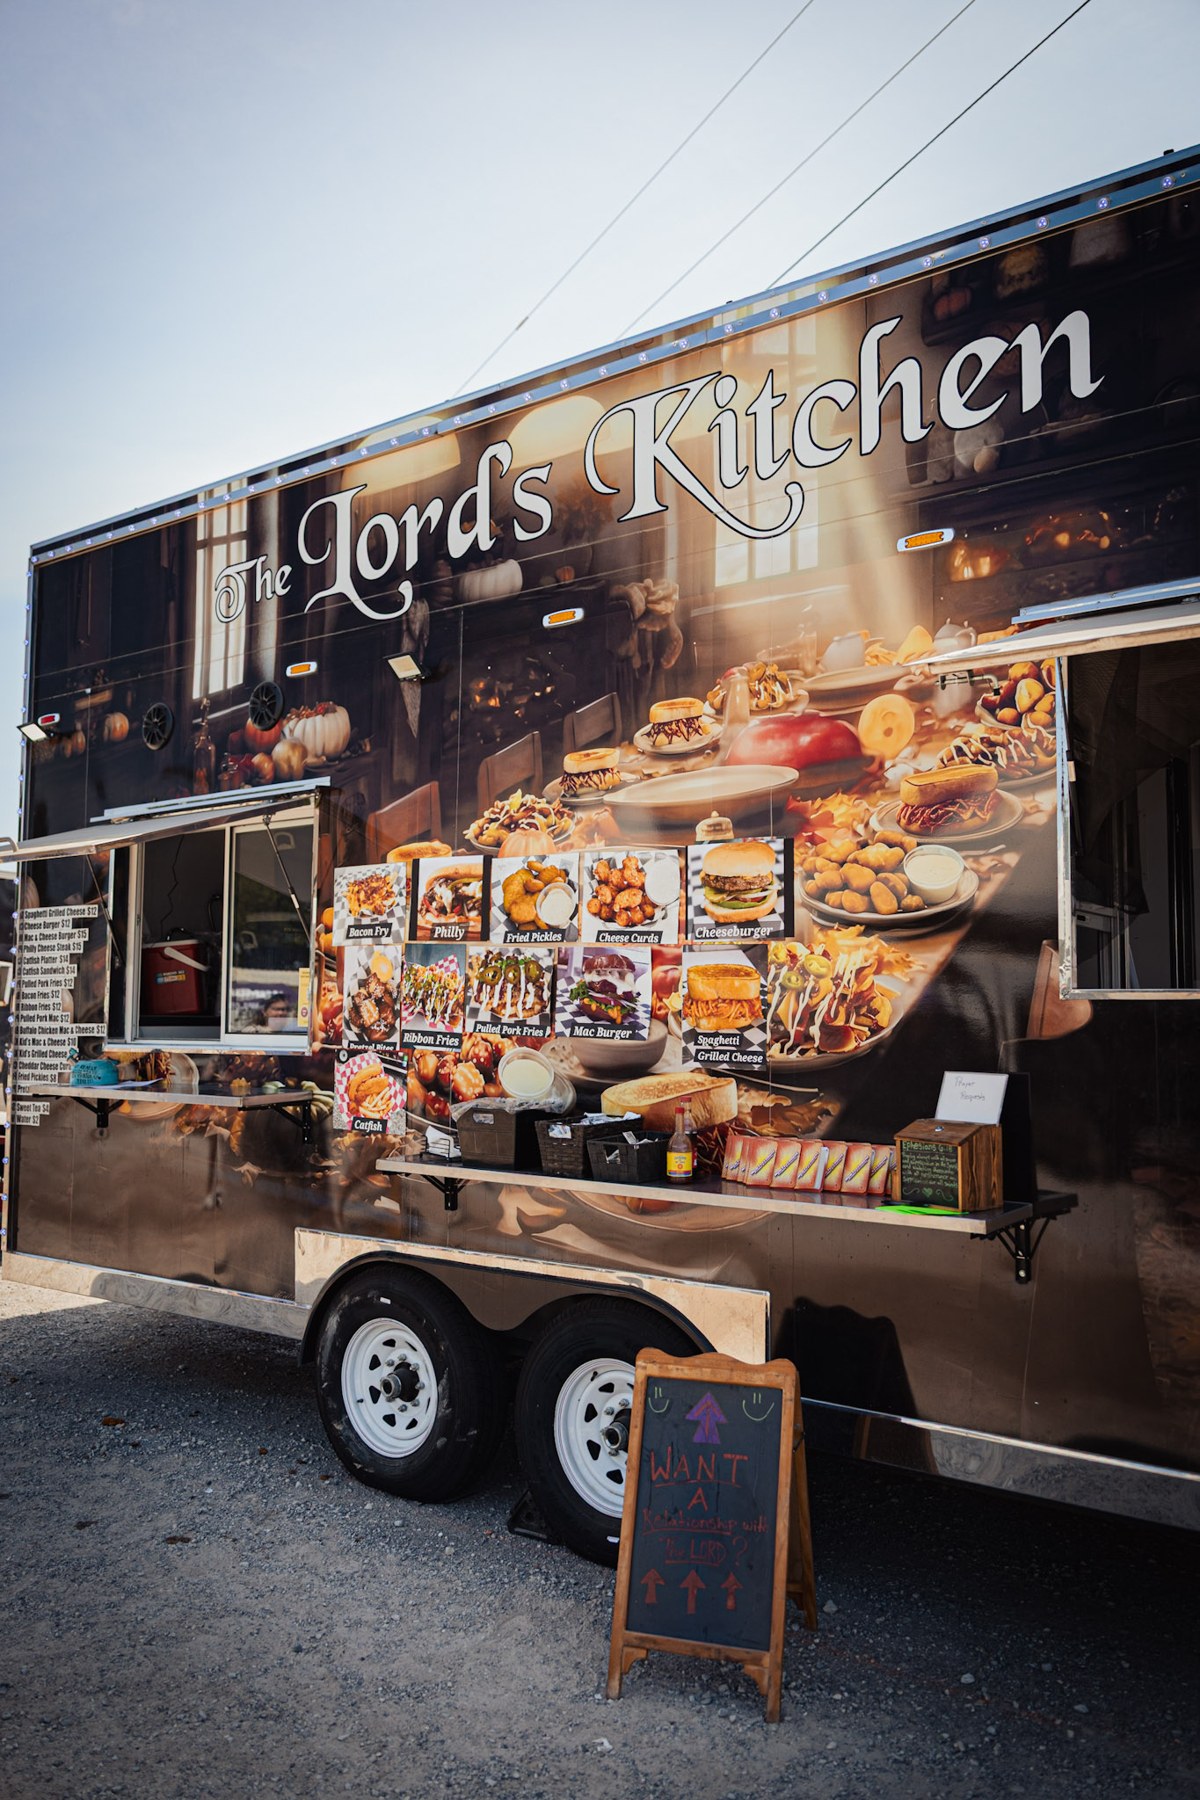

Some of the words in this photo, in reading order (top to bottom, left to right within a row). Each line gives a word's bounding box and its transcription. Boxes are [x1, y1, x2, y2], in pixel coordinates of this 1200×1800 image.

[215, 554, 292, 623] The
[298, 440, 554, 620] Lord's
[585, 309, 1106, 540] Kitchen
[24, 909, 48, 919] Spaghetti
[49, 908, 65, 917] Grilled
[66, 907, 86, 916] Cheese
[87, 906, 97, 916] $12
[24, 921, 42, 930] Cheese
[43, 920, 60, 930] Burger
[61, 920, 71, 928] $12
[24, 933, 34, 941] Mac
[39, 932, 57, 941] Cheese
[58, 931, 76, 941] Burger
[77, 929, 87, 939] $15
[348, 926, 373, 938] Bacon
[374, 926, 390, 939] Fry
[433, 925, 466, 940] Philly
[506, 932, 529, 943] Fried
[530, 931, 562, 943] Pickles
[598, 933, 630, 943] Cheese
[631, 933, 659, 943] Curds
[695, 926, 774, 938] Cheeseburger
[23, 944, 36, 953] Philly
[37, 943, 56, 952] Cheese
[57, 942, 71, 951] Steak
[72, 941, 82, 951] $15
[23, 956, 40, 965] Catfish
[41, 955, 58, 964] Platter
[59, 954, 69, 964] $14
[23, 967, 39, 976] Catfish
[40, 966, 65, 975] Sandwich
[66, 965, 76, 975] $14
[22, 979, 37, 988] Pulled
[38, 979, 49, 988] Pork
[50, 979, 62, 987] Fries
[64, 978, 73, 987] $12
[21, 991, 37, 1000] Bacon
[37, 991, 50, 999] Fries
[51, 989, 60, 999] $12
[20, 1002, 37, 1012] Ribbon
[39, 1002, 51, 1011] Fries
[52, 1002, 62, 1011] $12
[20, 1014, 35, 1023] Pulled
[36, 1014, 48, 1023] Pork
[48, 1014, 59, 1022] Mac
[60, 1014, 70, 1023] $12
[20, 1026, 37, 1035] Buffalo
[38, 1026, 58, 1035] Chicken
[59, 1026, 69, 1034] Mac
[75, 1025, 95, 1034] Cheese
[96, 1024, 106, 1034] $12
[475, 1023, 501, 1034] Pulled
[501, 1025, 522, 1035] Pork
[522, 1026, 544, 1037] Fries
[573, 1026, 598, 1037] Mac
[597, 1027, 632, 1039] Burger
[20, 1038, 31, 1046] Kid's
[32, 1038, 42, 1046] Mac
[47, 1037, 66, 1046] Cheese
[403, 1032, 435, 1045] Ribbon
[435, 1034, 460, 1046] Fries
[697, 1035, 740, 1047] Spaghetti
[19, 1050, 31, 1058] Kid's
[32, 1049, 48, 1058] Grilled
[49, 1049, 67, 1058] Cheese
[697, 1051, 731, 1062] Grilled
[731, 1052, 764, 1063] Cheese
[19, 1061, 39, 1070] Cheddar
[40, 1062, 58, 1070] Cheese
[60, 1062, 71, 1071] Cur
[18, 1073, 30, 1082] Fried
[31, 1073, 49, 1082] Pickles
[50, 1073, 57, 1082] $8
[17, 1084, 29, 1093] Pret
[16, 1103, 32, 1112] Sweet
[32, 1104, 41, 1112] Tea
[42, 1104, 49, 1113] $4
[16, 1114, 31, 1123] Water
[32, 1115, 39, 1124] $2
[354, 1119, 383, 1132] Catfish
[650, 1446, 748, 1484] WANT
[688, 1487, 708, 1511] A
[642, 1507, 737, 1532] Relationship
[742, 1515, 768, 1533] with
